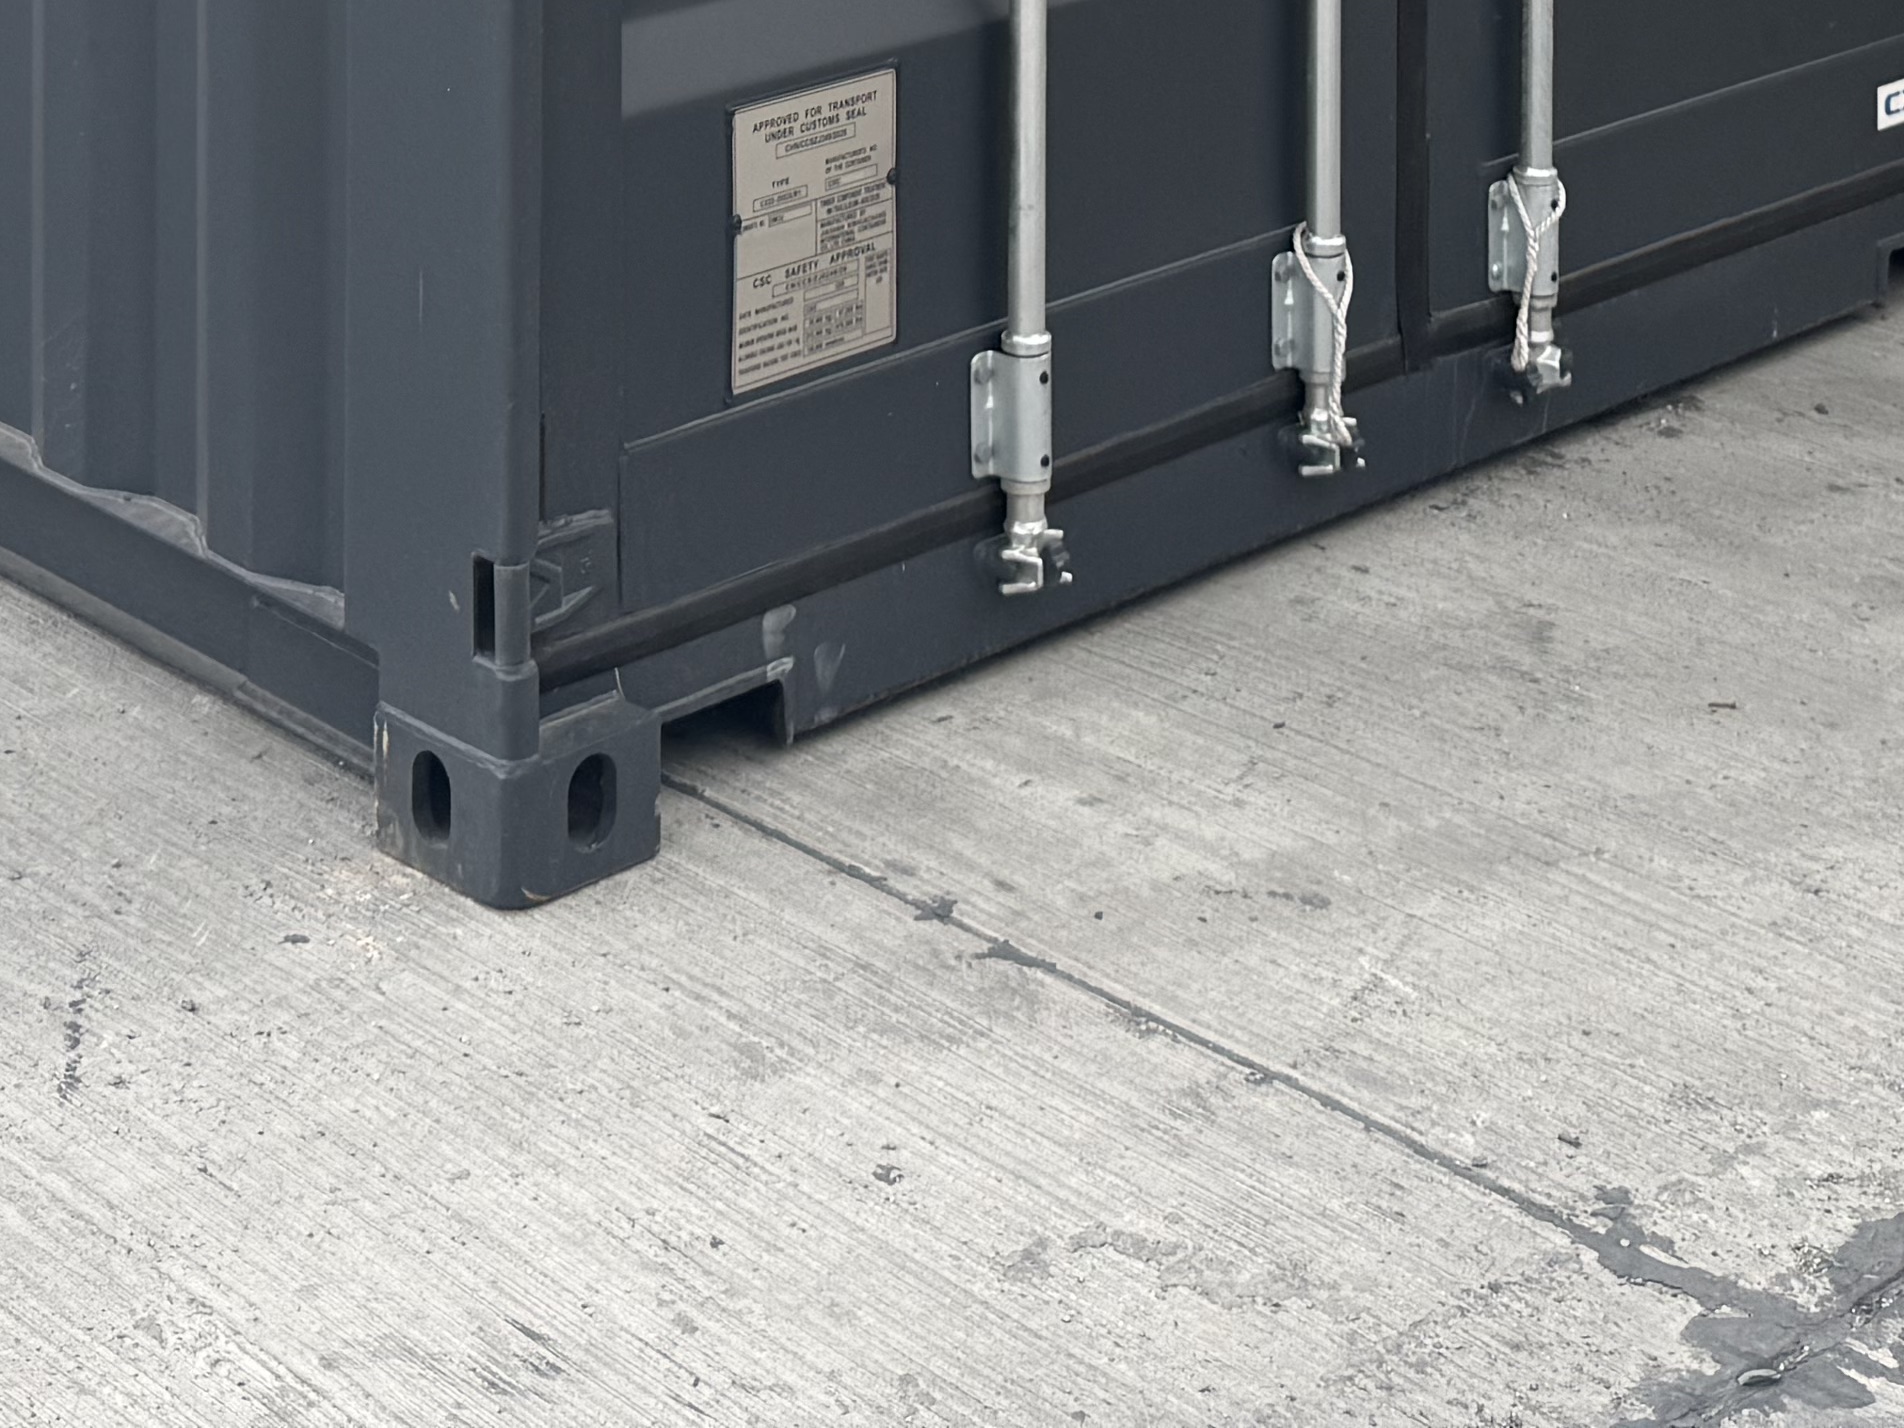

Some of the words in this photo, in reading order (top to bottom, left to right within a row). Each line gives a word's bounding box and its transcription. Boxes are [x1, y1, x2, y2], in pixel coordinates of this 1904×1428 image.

[752, 112, 799, 133] APPROVED
[805, 106, 823, 120] FOR
[828, 90, 877, 112] TRANSPORT
[764, 126, 794, 143] UNDER
[800, 114, 840, 133] CUSTOMS
[846, 107, 867, 121] SEAL
[752, 274, 773, 289] CSC
[785, 259, 819, 279] SAFETY
[830, 242, 876, 265] APPROVAL
